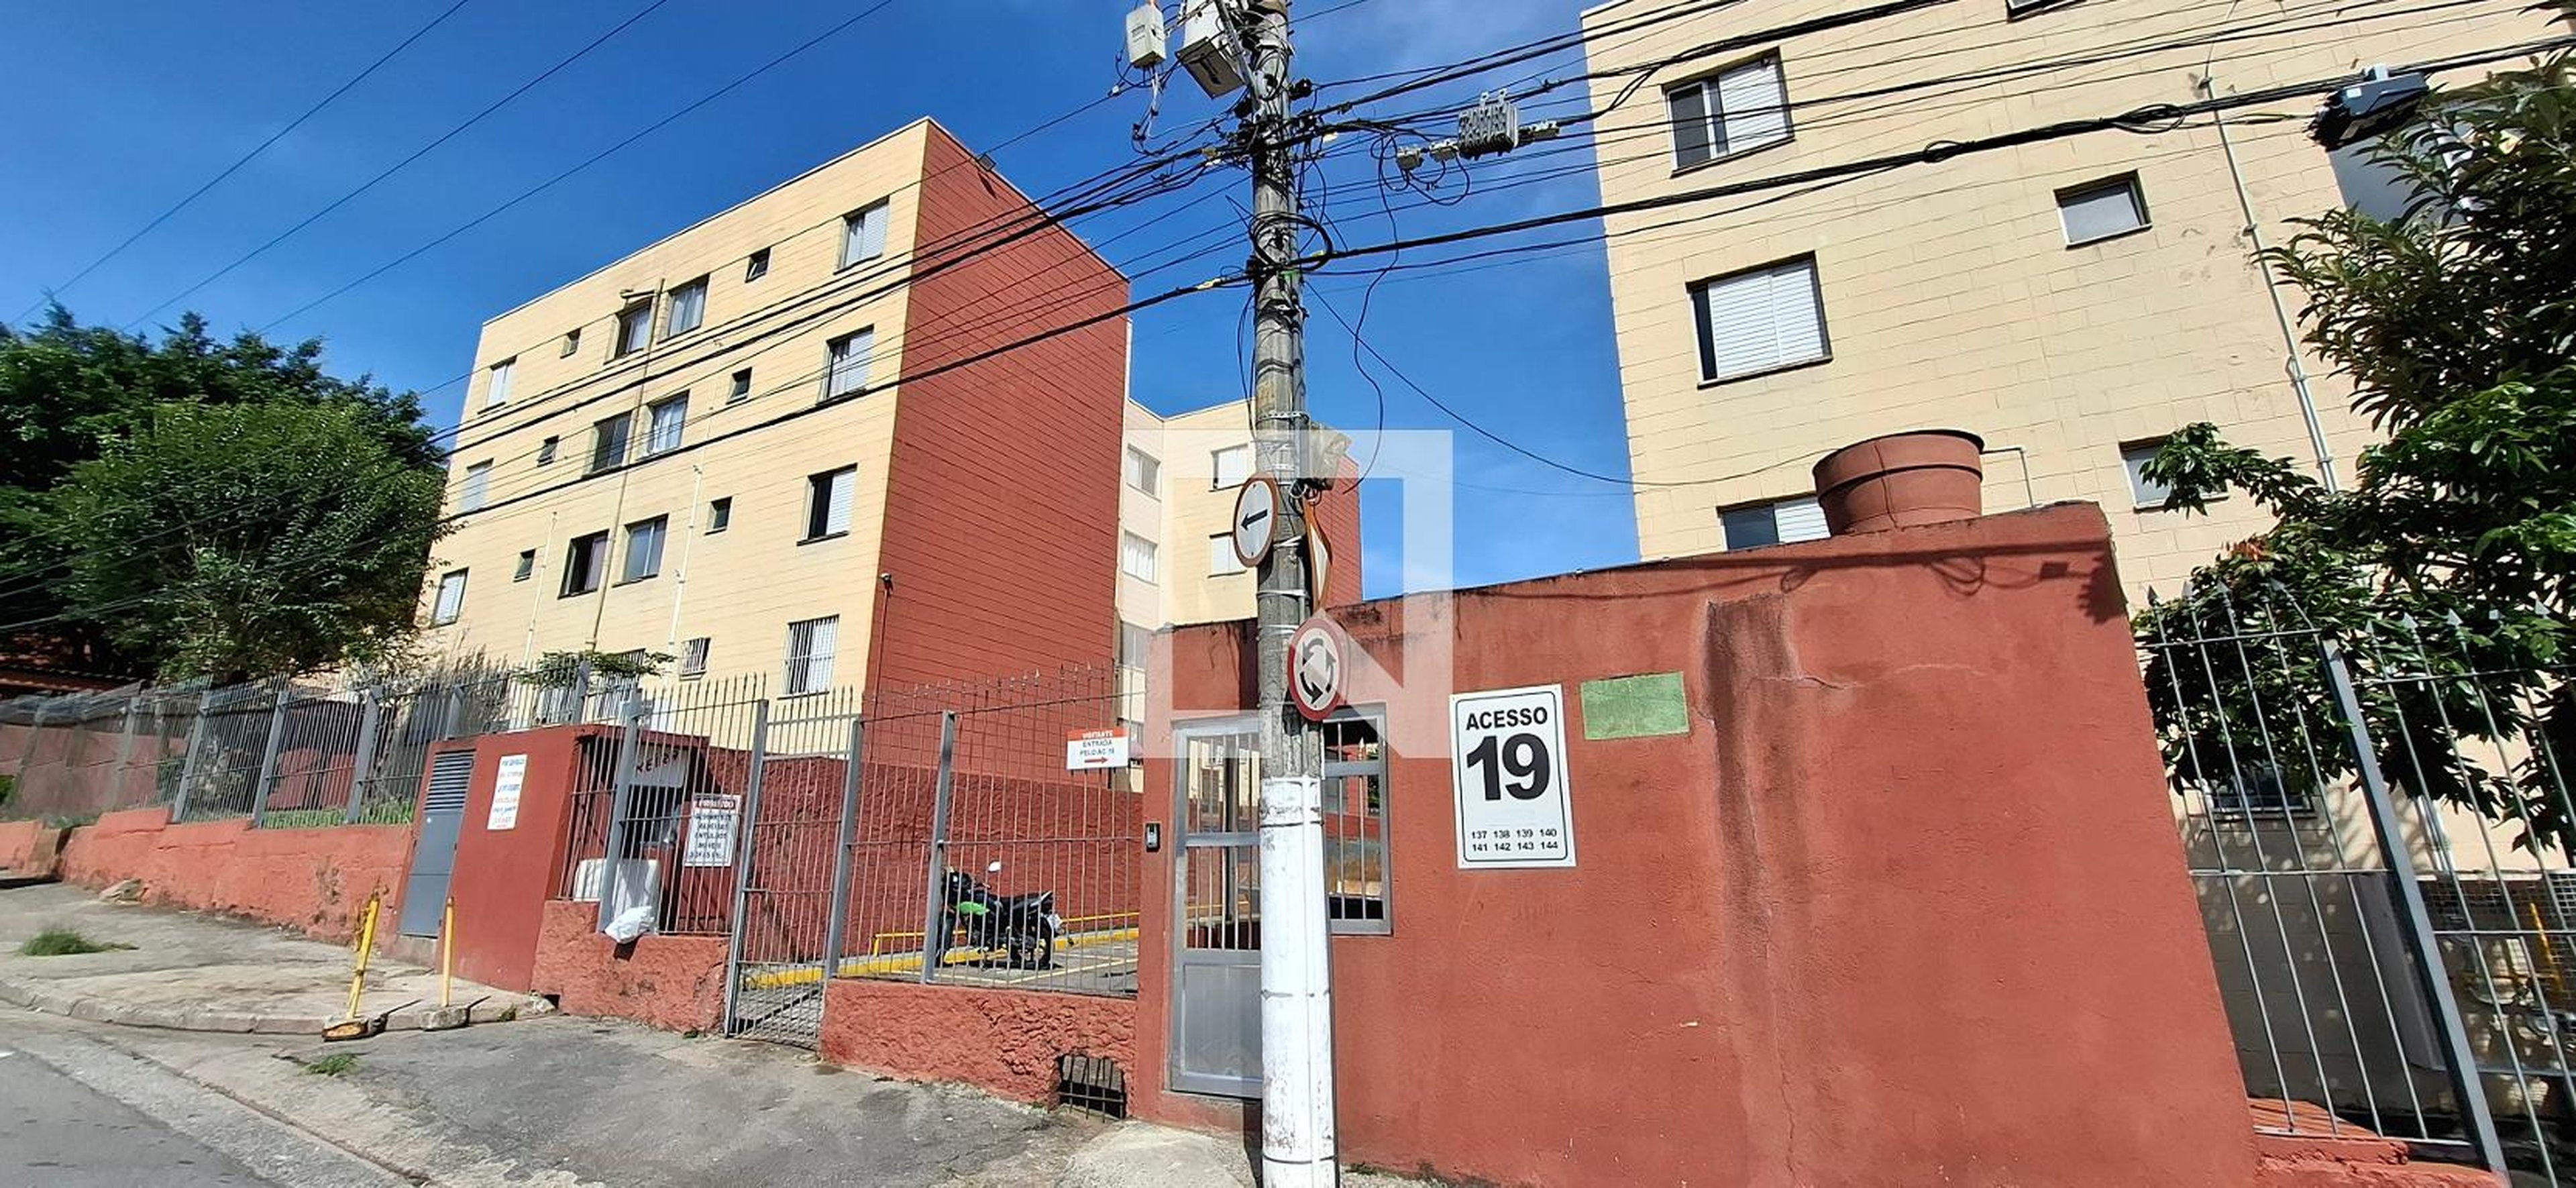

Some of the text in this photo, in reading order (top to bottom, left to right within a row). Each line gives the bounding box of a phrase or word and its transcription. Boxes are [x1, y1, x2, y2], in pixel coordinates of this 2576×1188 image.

[1466, 706, 1548, 731] ACESSO
[1466, 733, 1550, 800] 19
[1472, 828, 1557, 839] 137 138 139 140
[1472, 841, 1558, 851] 141 142 143 144
